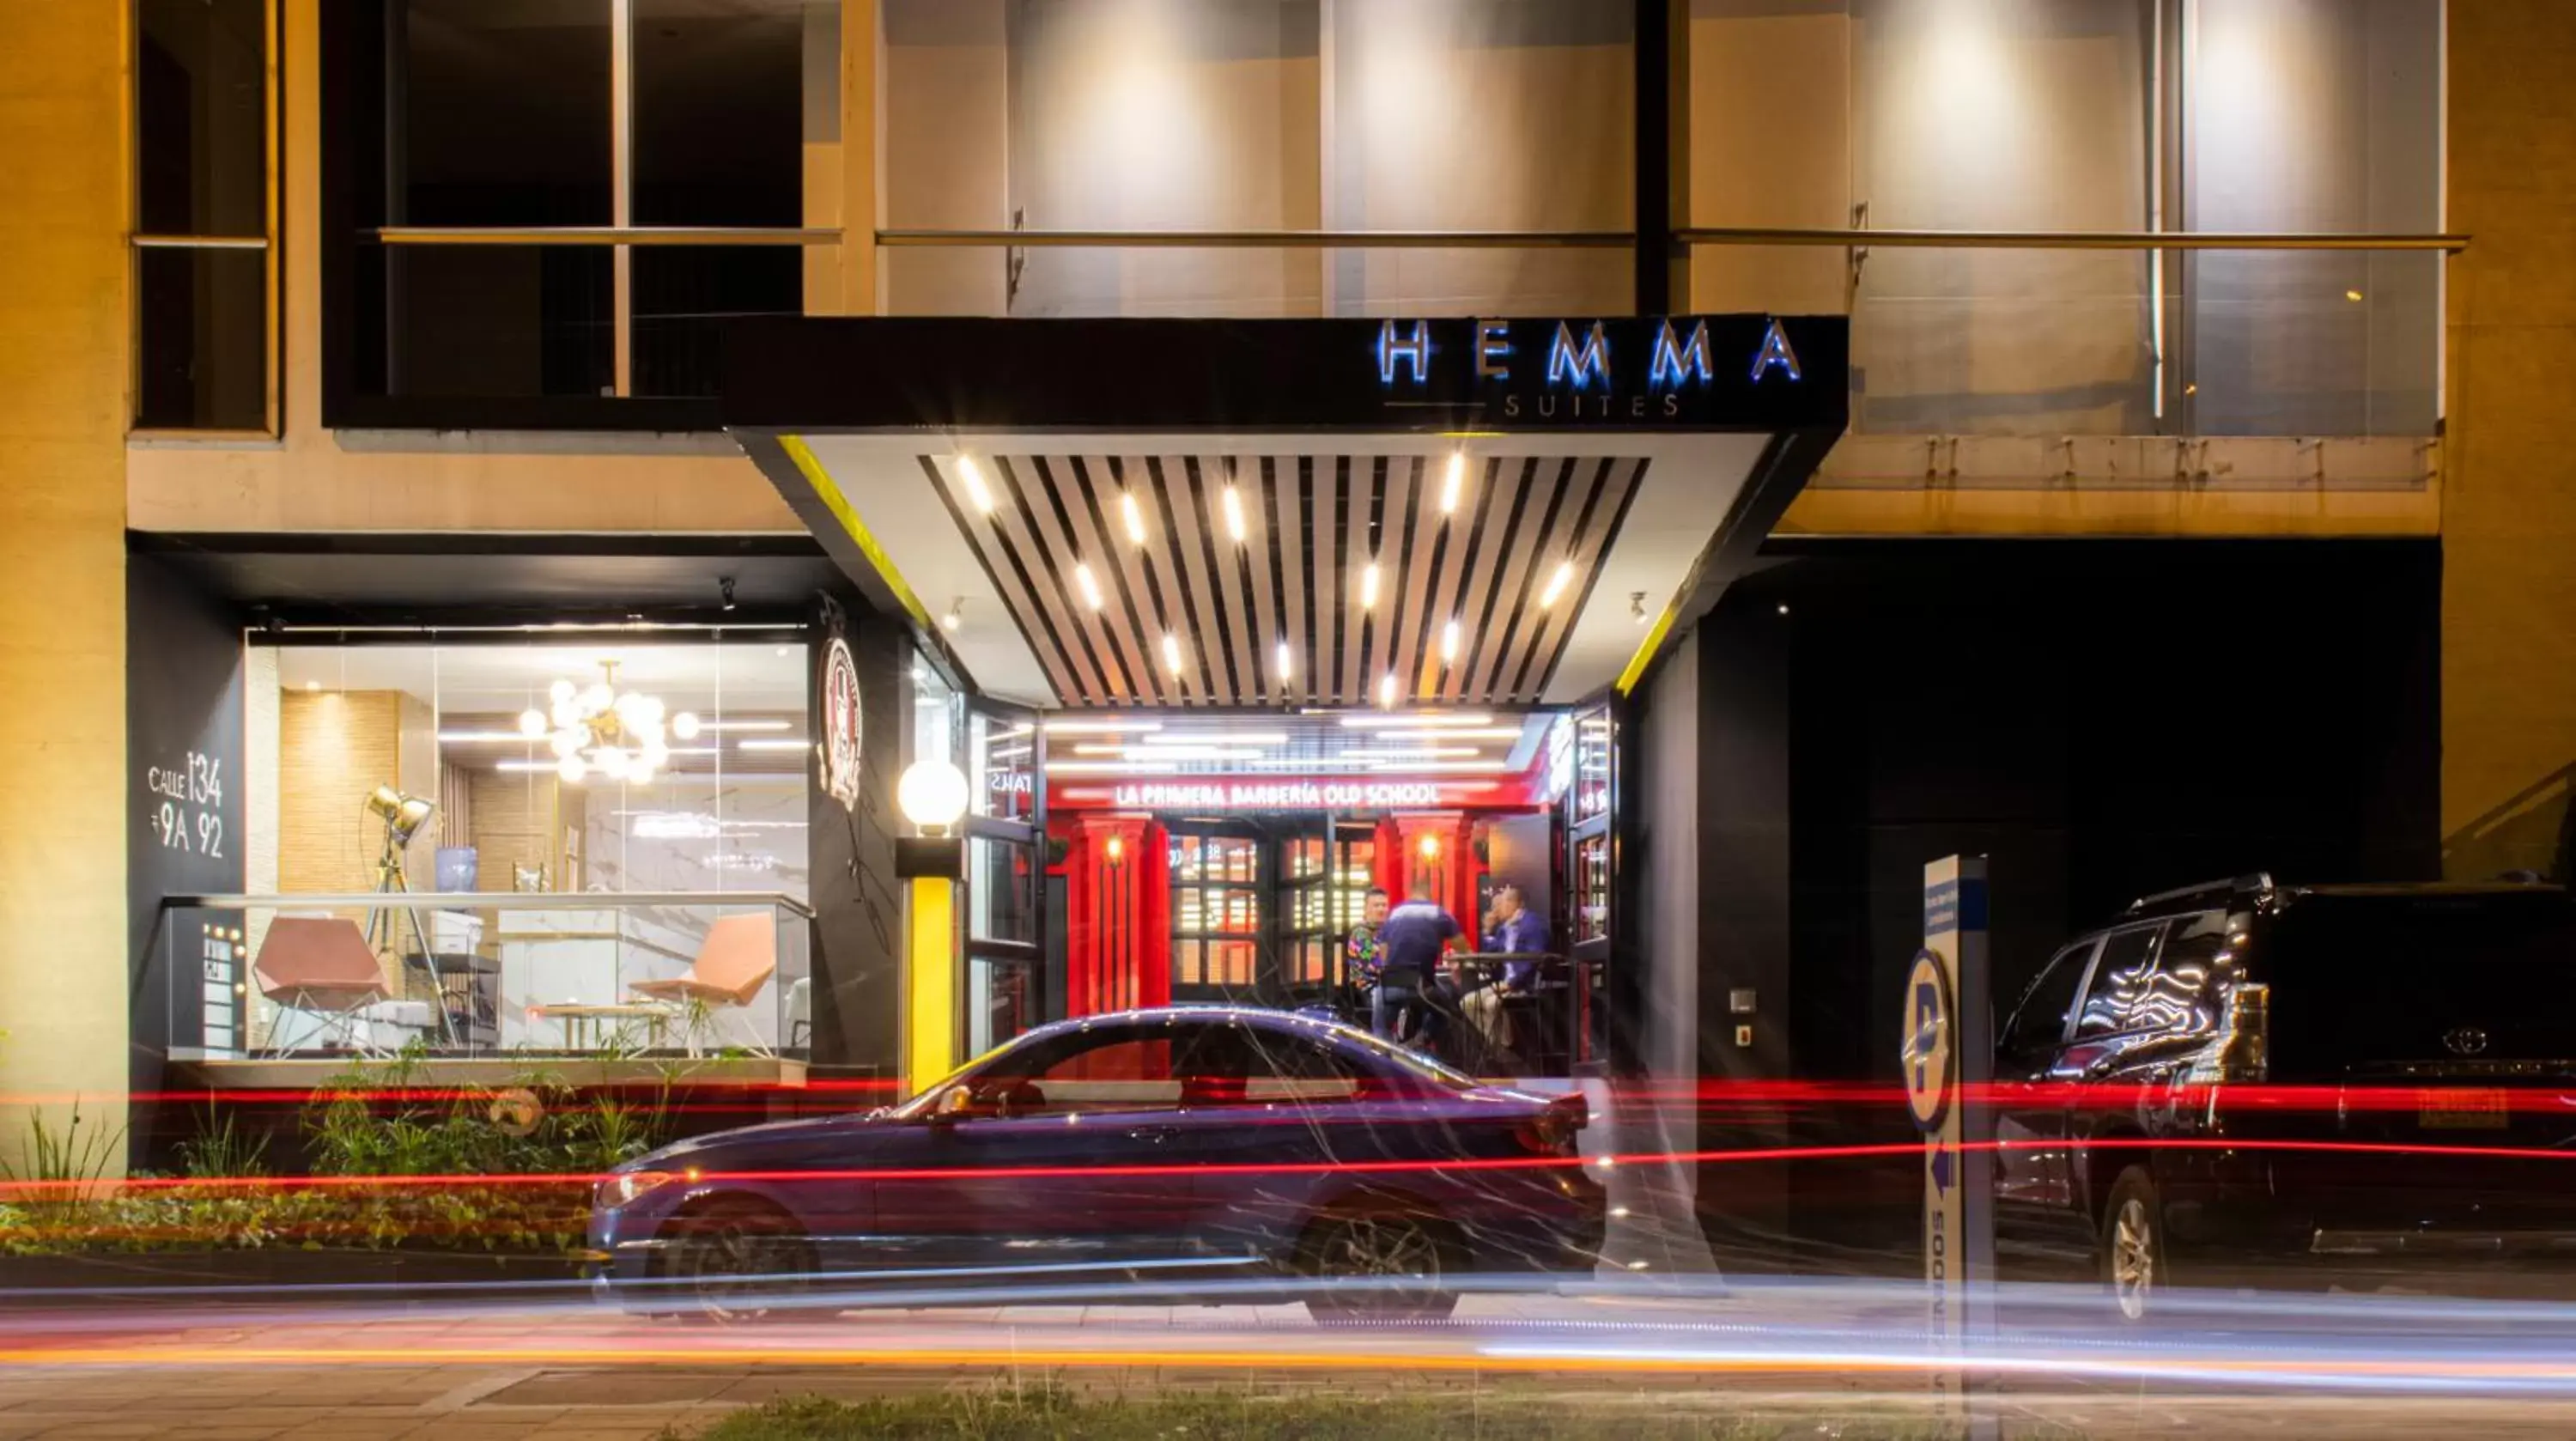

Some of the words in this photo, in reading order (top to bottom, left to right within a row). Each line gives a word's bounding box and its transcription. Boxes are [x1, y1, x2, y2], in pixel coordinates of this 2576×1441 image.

[1377, 318, 1802, 381] HEMMA
[1504, 392, 1679, 416] SUITES
[148, 765, 185, 800] CALLE
[186, 751, 223, 807] 134
[1116, 784, 1139, 806] LA
[1142, 784, 1225, 806] PRIMERA
[1324, 785, 1362, 806] OLD
[1367, 783, 1441, 805] SCHOOL
[197, 811, 223, 858] 92
